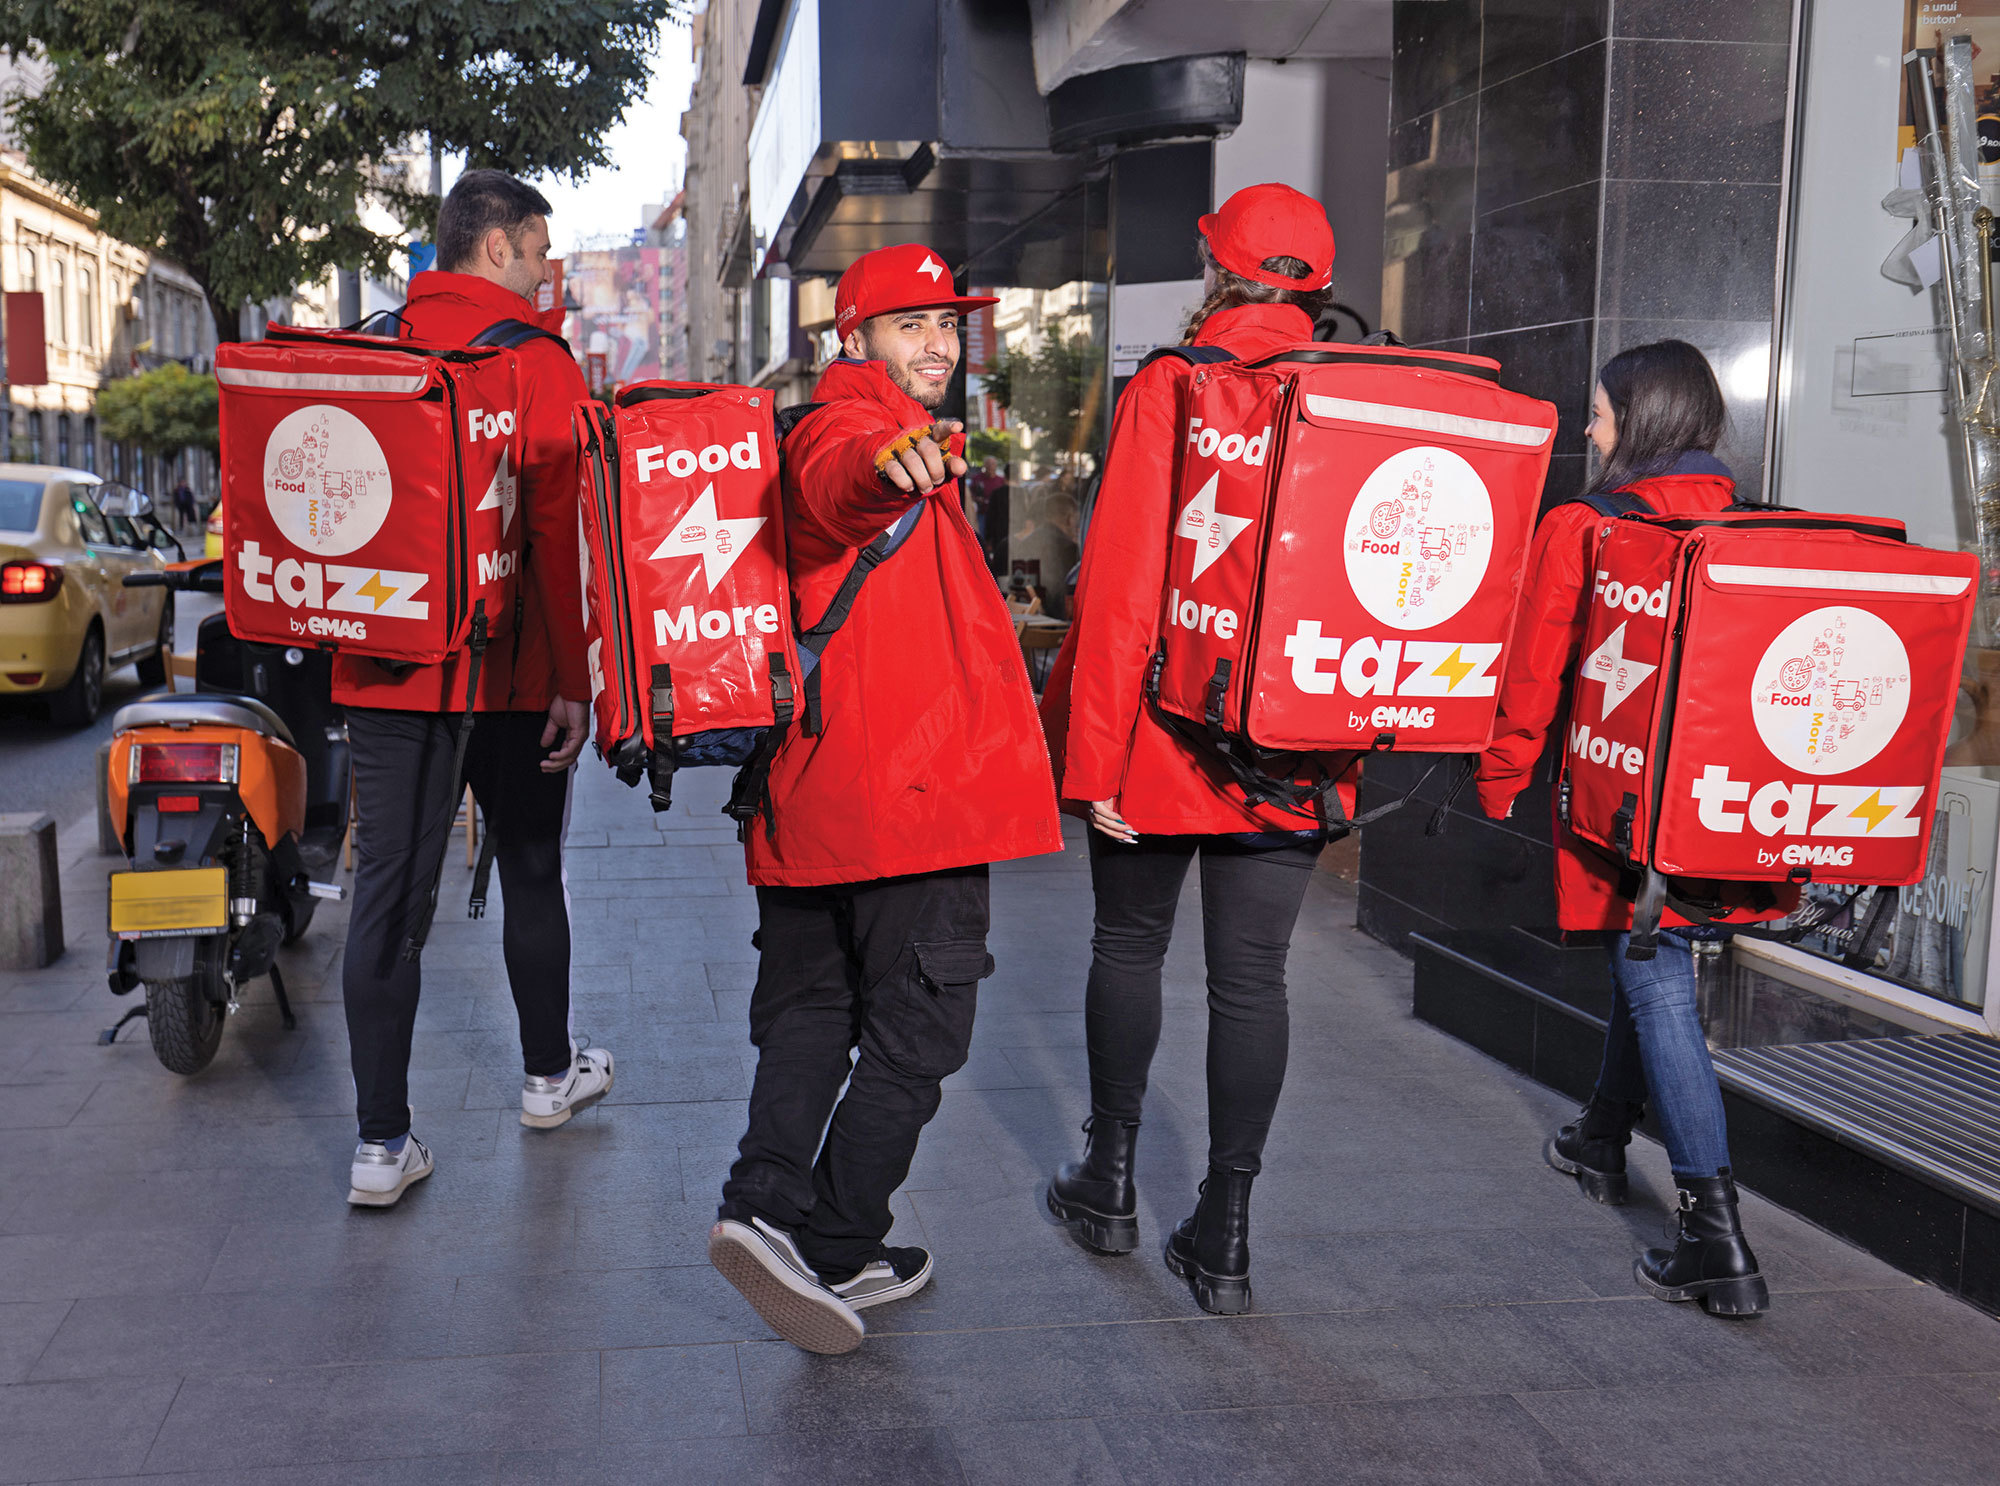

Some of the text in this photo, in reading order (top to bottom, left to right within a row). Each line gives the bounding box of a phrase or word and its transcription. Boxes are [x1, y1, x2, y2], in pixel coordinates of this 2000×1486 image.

[1932, 1, 1957, 11] unui
[468, 408, 517, 443] Foo
[1186, 417, 1273, 467] Food
[635, 431, 762, 483] Food
[275, 479, 305, 494] Food
[308, 498, 319, 537] More
[1360, 539, 1400, 556] Food
[238, 539, 430, 620] tazz
[1396, 561, 1413, 609] More
[1592, 569, 1672, 619] Food
[289, 617, 307, 636] by
[653, 603, 779, 647] More
[1283, 618, 1503, 699] tazz
[1347, 710, 1370, 732] by
[1770, 692, 1812, 707] Food
[1569, 721, 1645, 776] More
[1807, 712, 1824, 756] More
[1690, 763, 1926, 839] tazz
[1756, 847, 1781, 868] by
